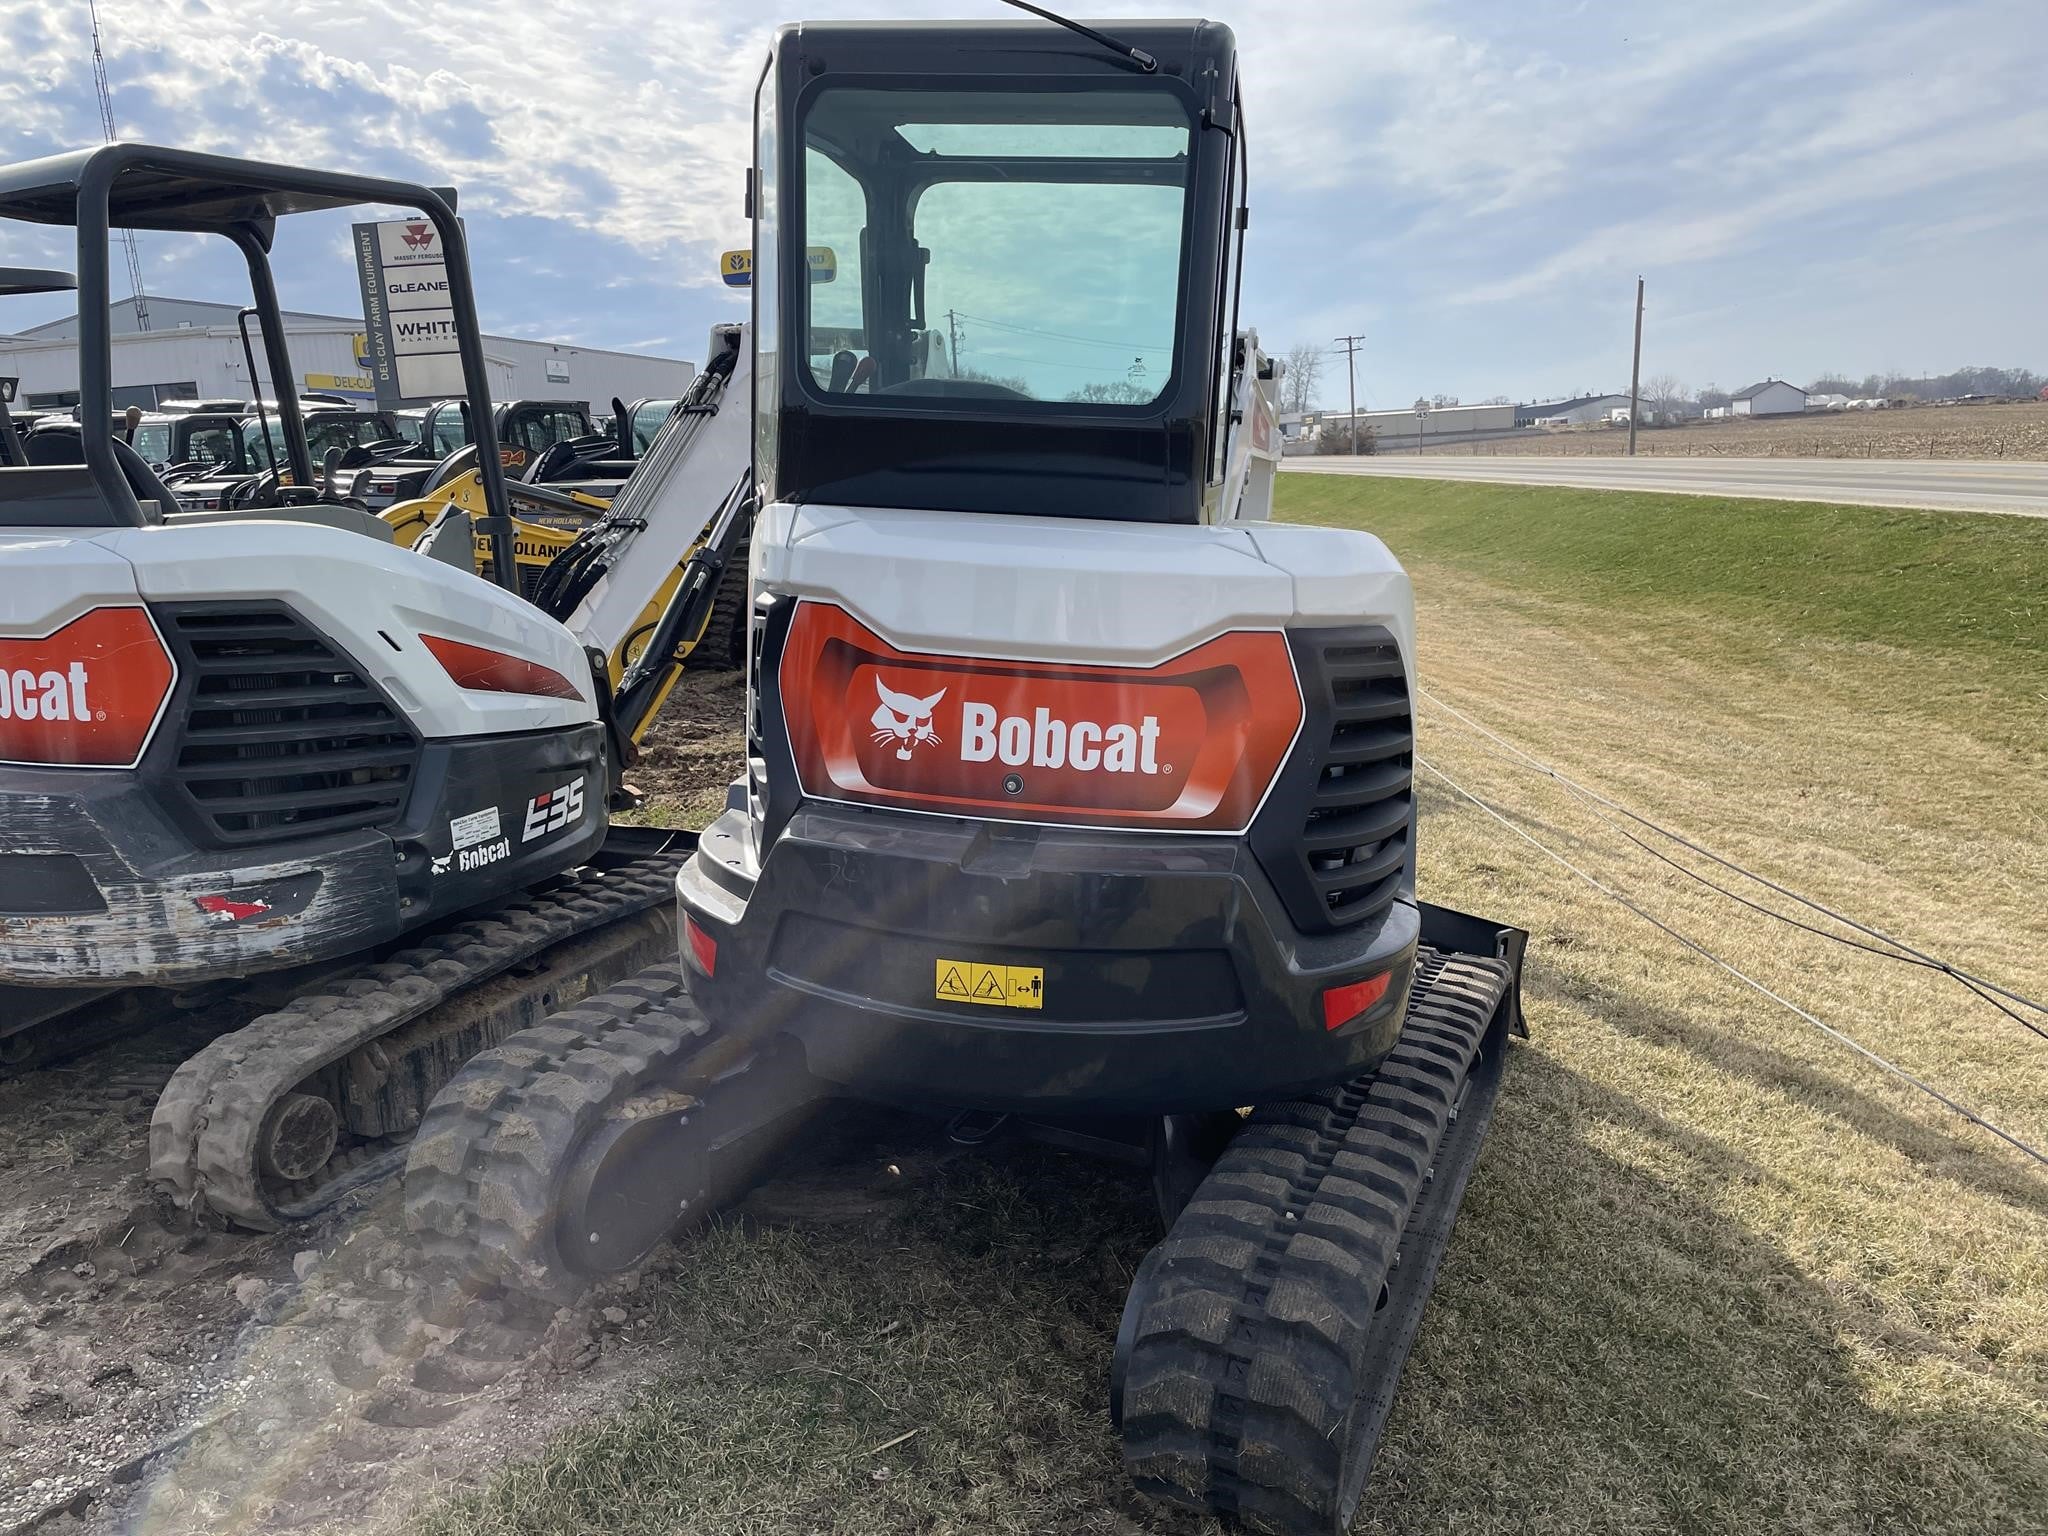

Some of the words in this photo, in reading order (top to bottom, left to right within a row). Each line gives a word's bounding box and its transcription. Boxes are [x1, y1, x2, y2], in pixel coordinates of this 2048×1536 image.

[360, 231, 377, 295] EQUIPMENT
[389, 281, 449, 294] GLEANE
[369, 297, 382, 328] FARM
[374, 332, 389, 381] DEL-CLAY
[538, 517, 552, 525] NEW
[553, 517, 583, 525] HOLLAND
[960, 701, 1159, 774] Bobcat
[521, 775, 584, 843] E35
[459, 836, 511, 872] Bobcat
